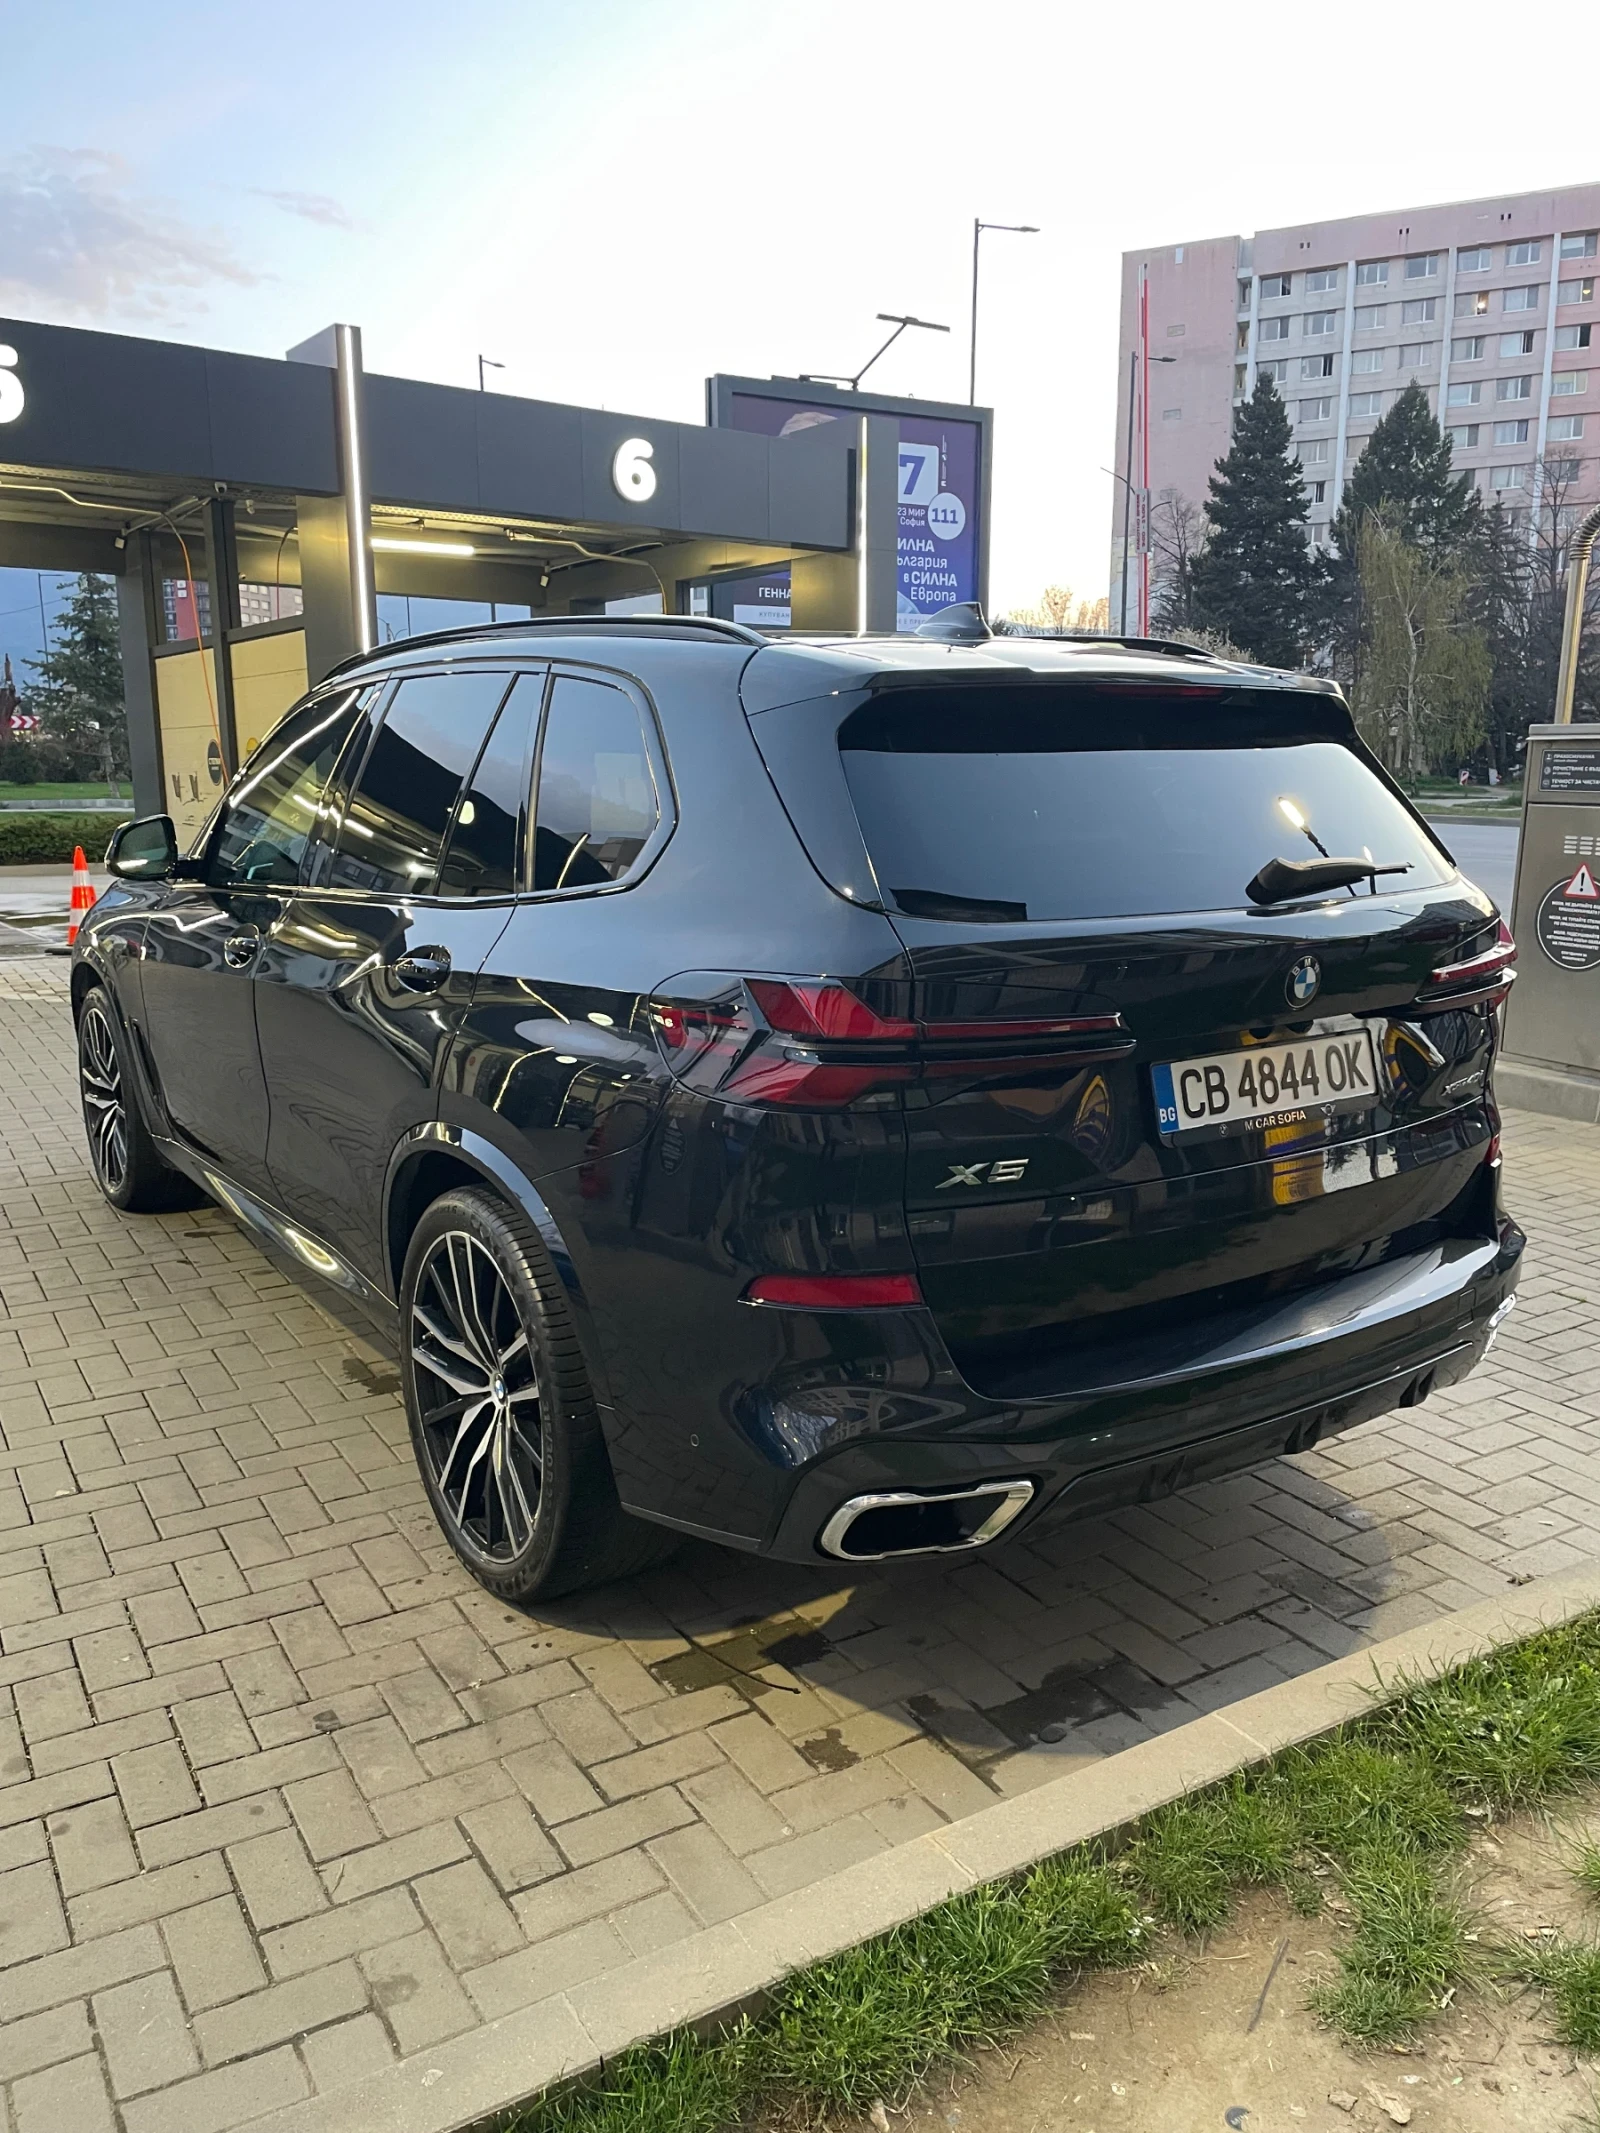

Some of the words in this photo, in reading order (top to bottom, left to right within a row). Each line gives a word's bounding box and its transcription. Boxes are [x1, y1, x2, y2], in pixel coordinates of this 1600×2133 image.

[613, 438, 657, 502] 6
[899, 454, 926, 495] 7
[900, 517, 925, 527] София
[931, 508, 958, 524] 111
[911, 571, 958, 587] СИЛНА
[911, 586, 957, 604] Европа
[1180, 1065, 1230, 1119] CB
[1238, 1048, 1320, 1108] 4844
[1325, 1040, 1369, 1092] OK
[1159, 1106, 1176, 1123] BG
[1255, 1113, 1277, 1129] CAR
[1277, 1110, 1307, 1124] SOFIA
[934, 1158, 1029, 1188] X5
